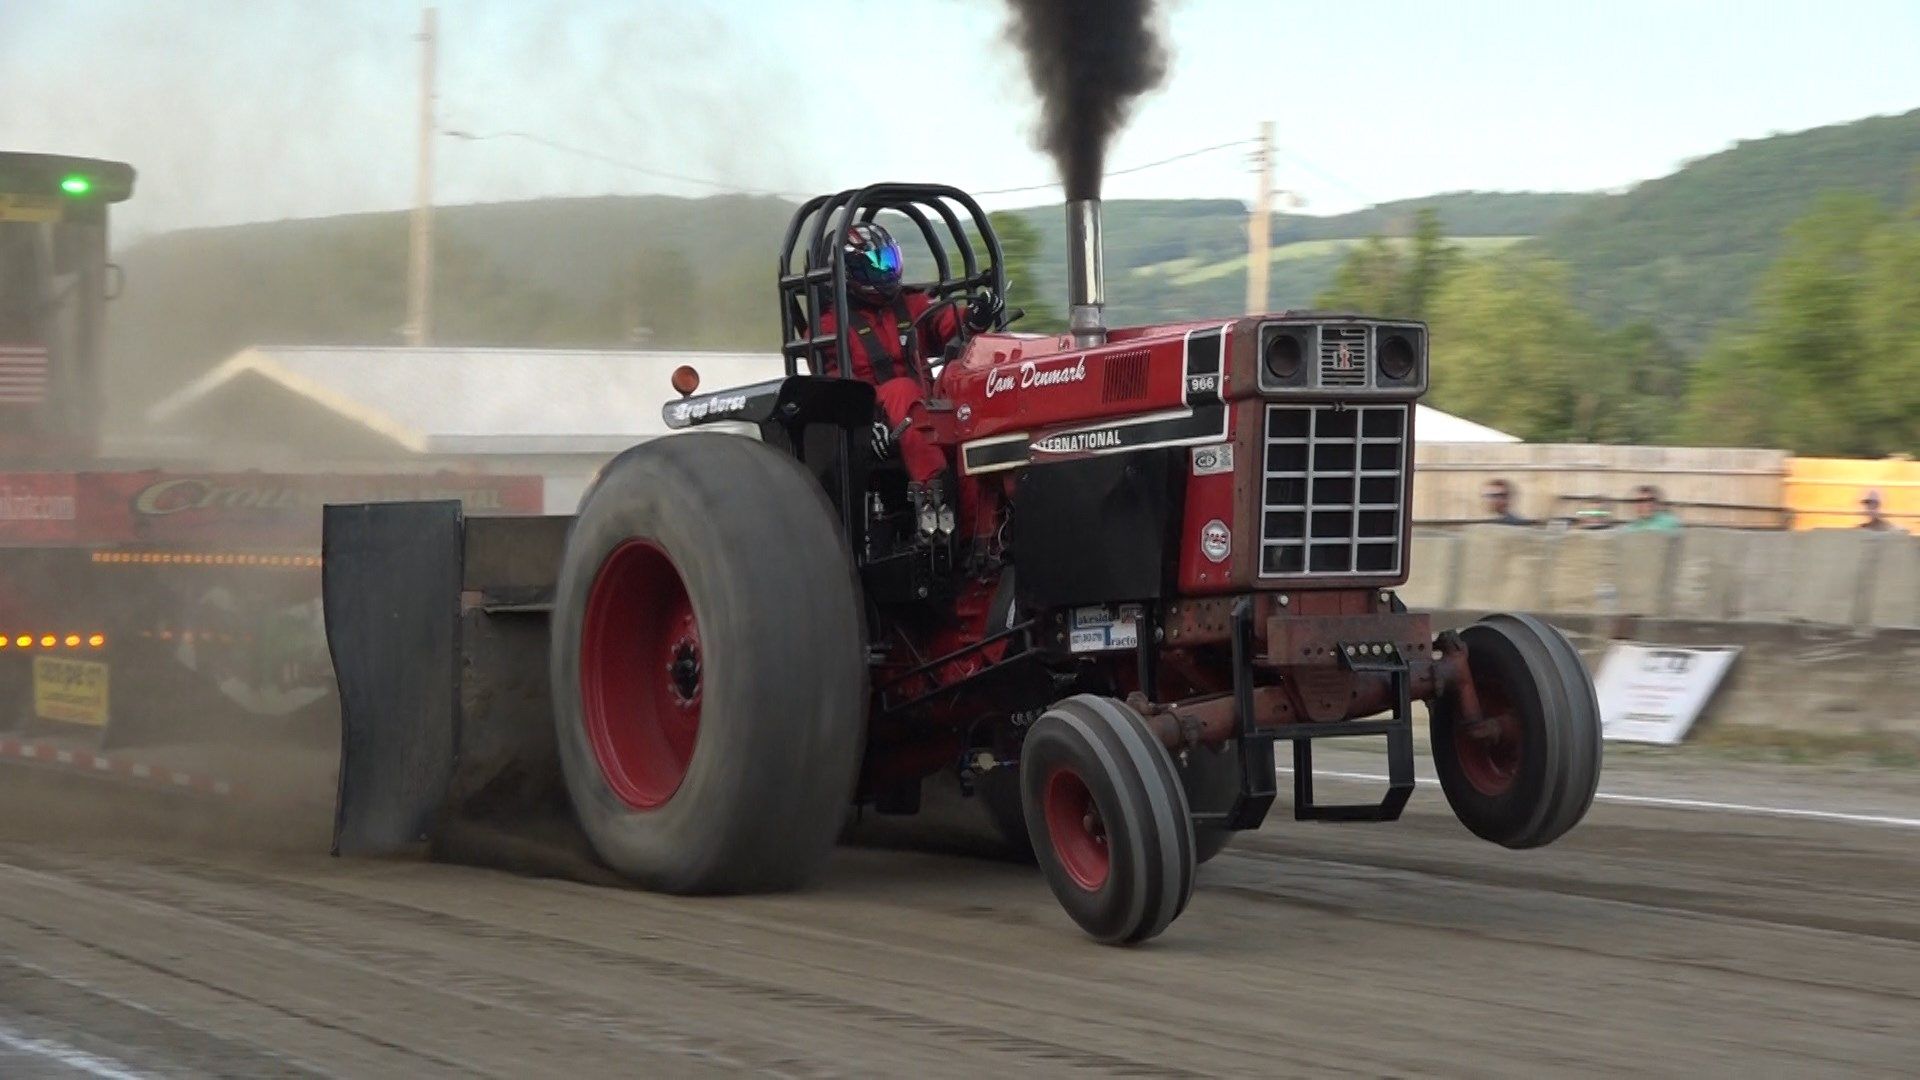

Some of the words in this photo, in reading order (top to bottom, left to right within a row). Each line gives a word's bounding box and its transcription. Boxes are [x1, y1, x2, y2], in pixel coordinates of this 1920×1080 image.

[986, 367, 1016, 398] Cam
[1020, 353, 1086, 389] Denmark
[1192, 376, 1214, 391] 966
[1040, 430, 1121, 451] TERNATIONAL
[1103, 625, 1138, 647] Tracto
